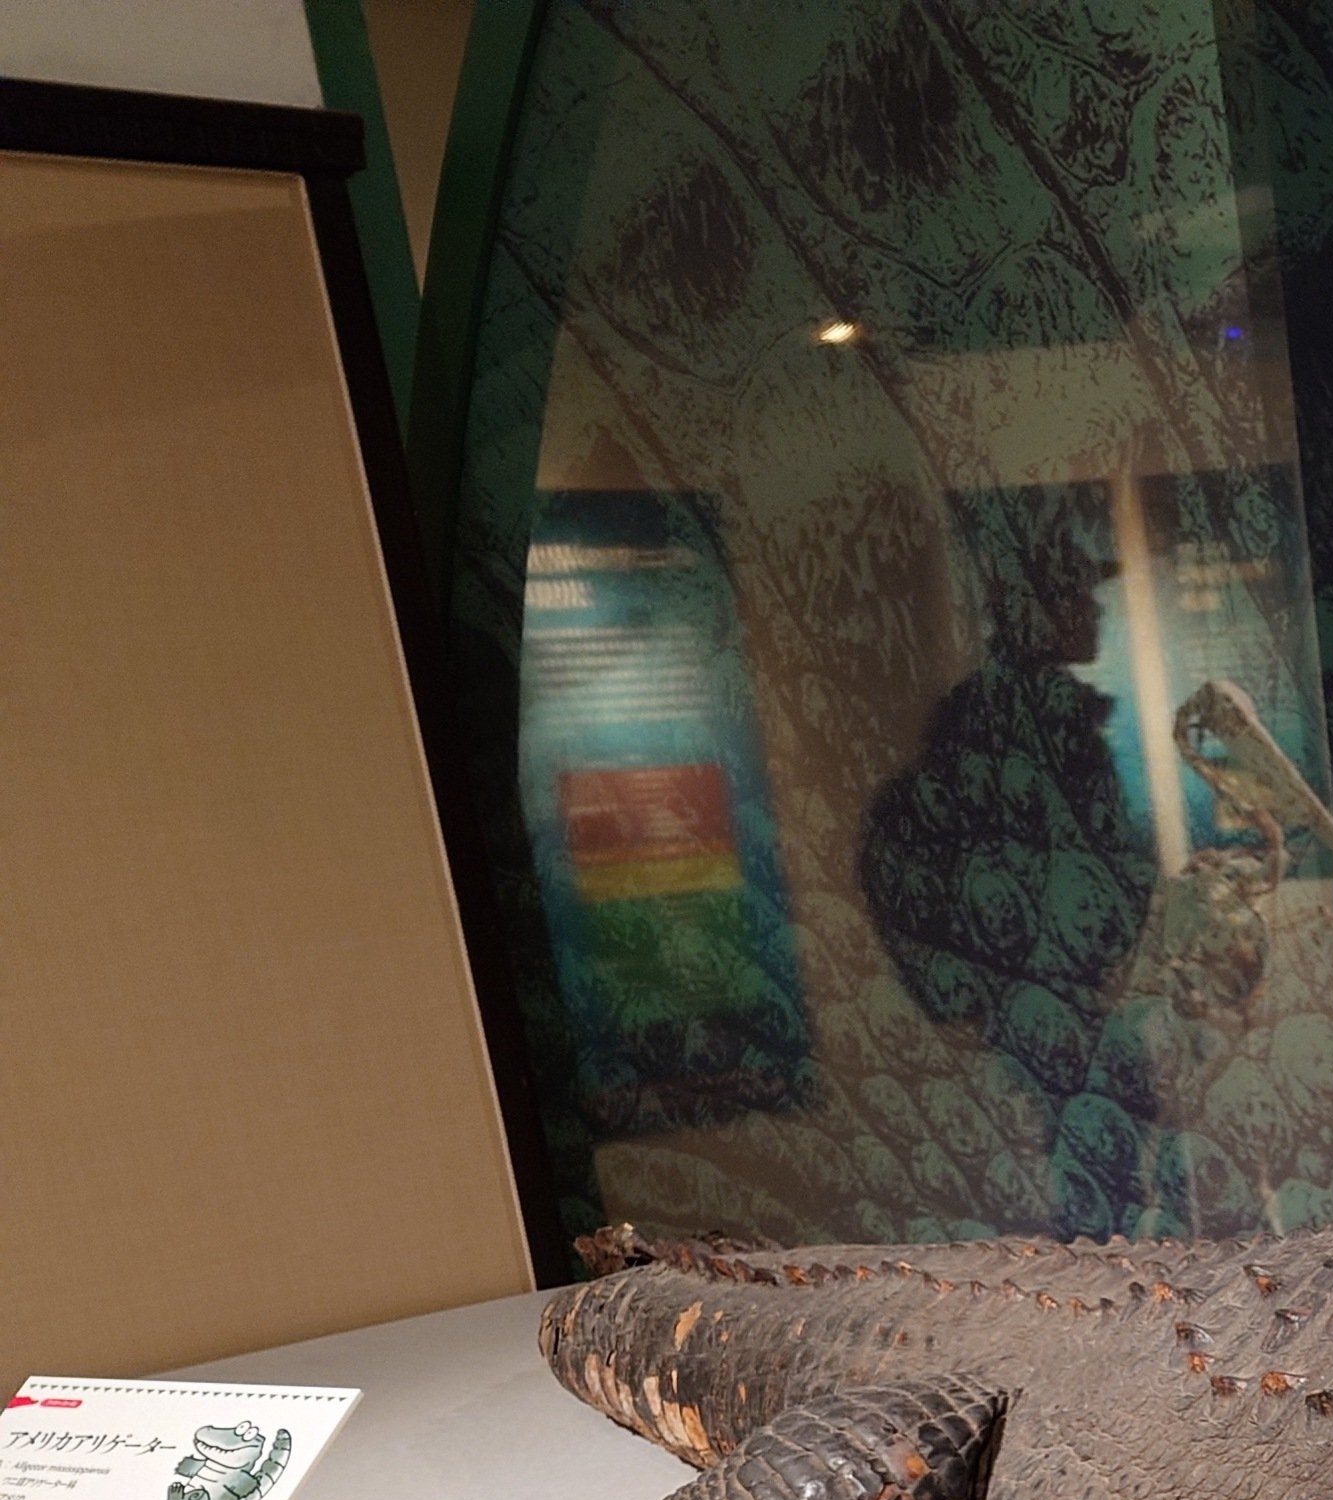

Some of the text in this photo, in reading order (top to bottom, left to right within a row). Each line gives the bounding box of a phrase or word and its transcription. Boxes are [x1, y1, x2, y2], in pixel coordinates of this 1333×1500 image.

[4, 1431, 177, 1457] アメリカアリゲーター
